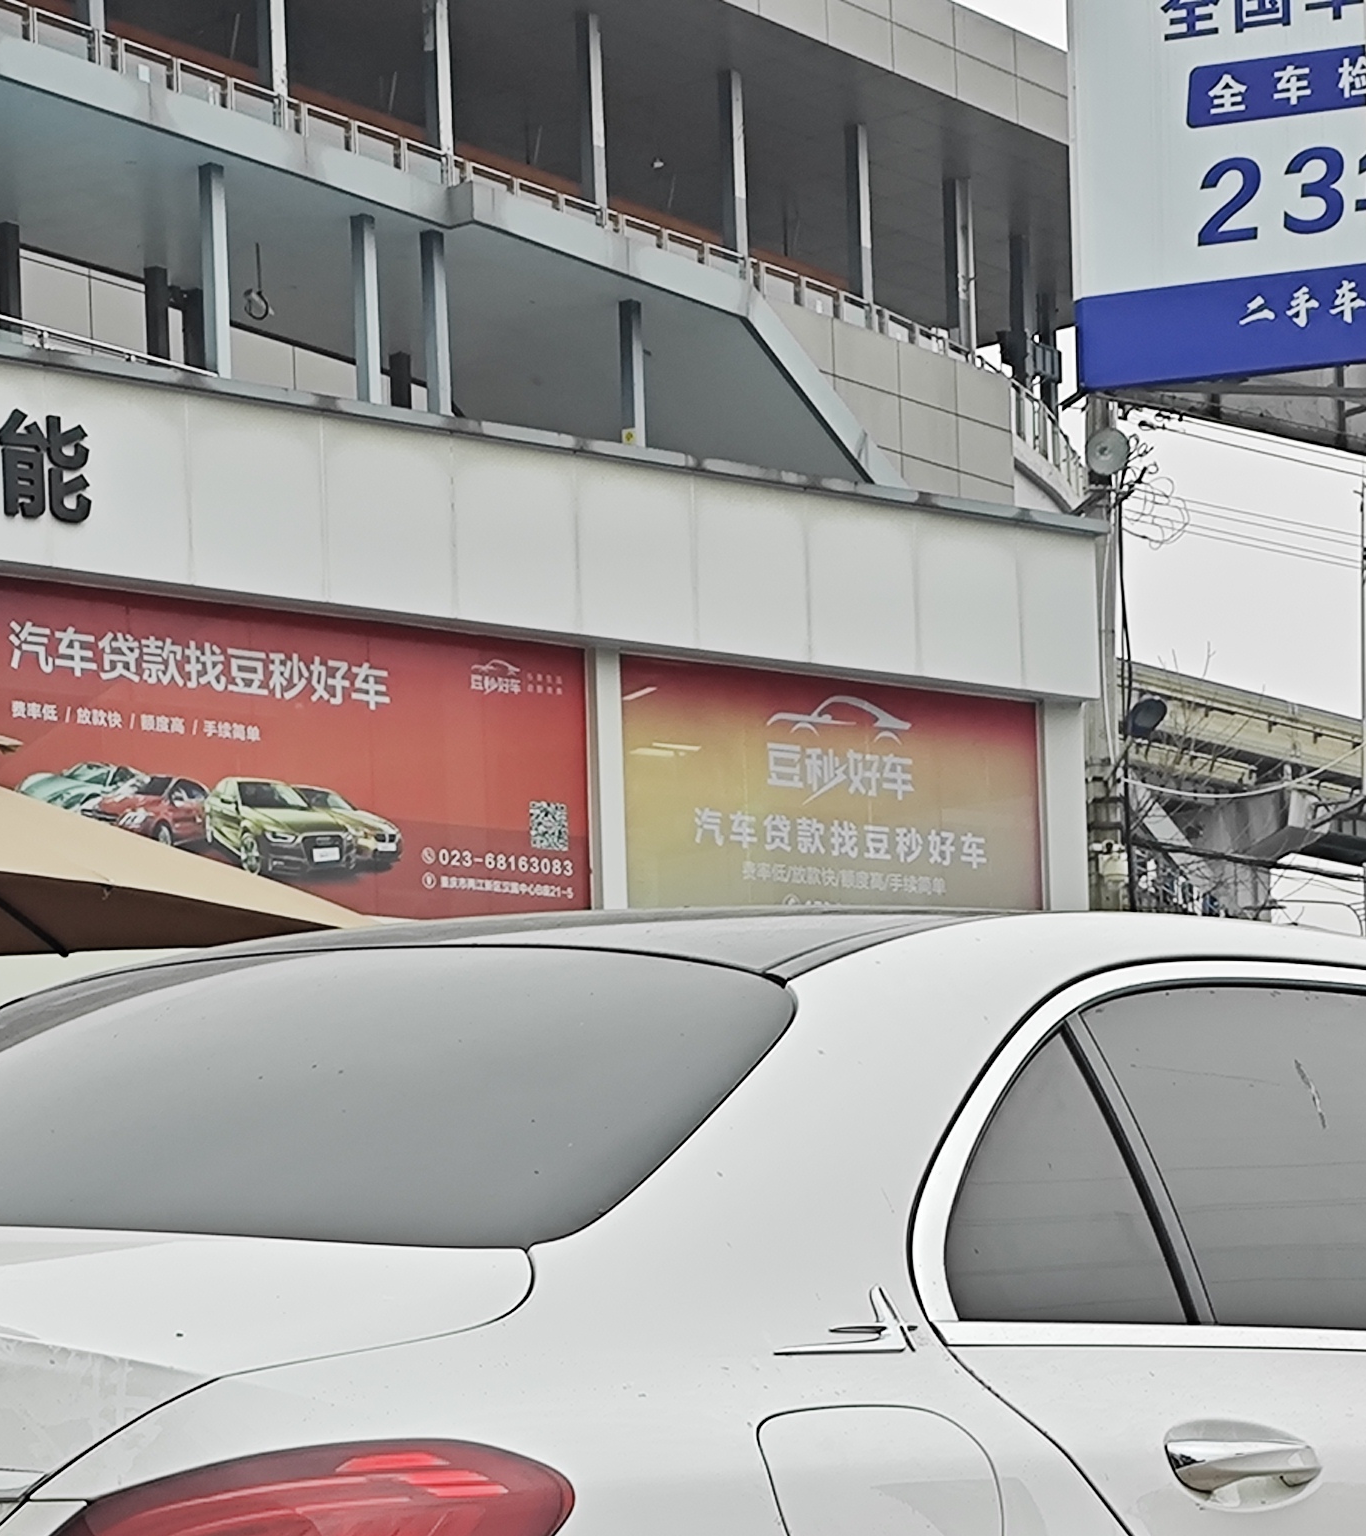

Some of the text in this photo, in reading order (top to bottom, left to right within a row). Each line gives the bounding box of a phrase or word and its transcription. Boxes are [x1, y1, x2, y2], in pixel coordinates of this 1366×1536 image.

[8, 620, 391, 711] 汽车贷款找豆秒好车
[767, 742, 915, 806] 豆秒好车
[438, 848, 573, 876] 023-68163083
[694, 807, 988, 869] 汽车贷款找豆秒好车
